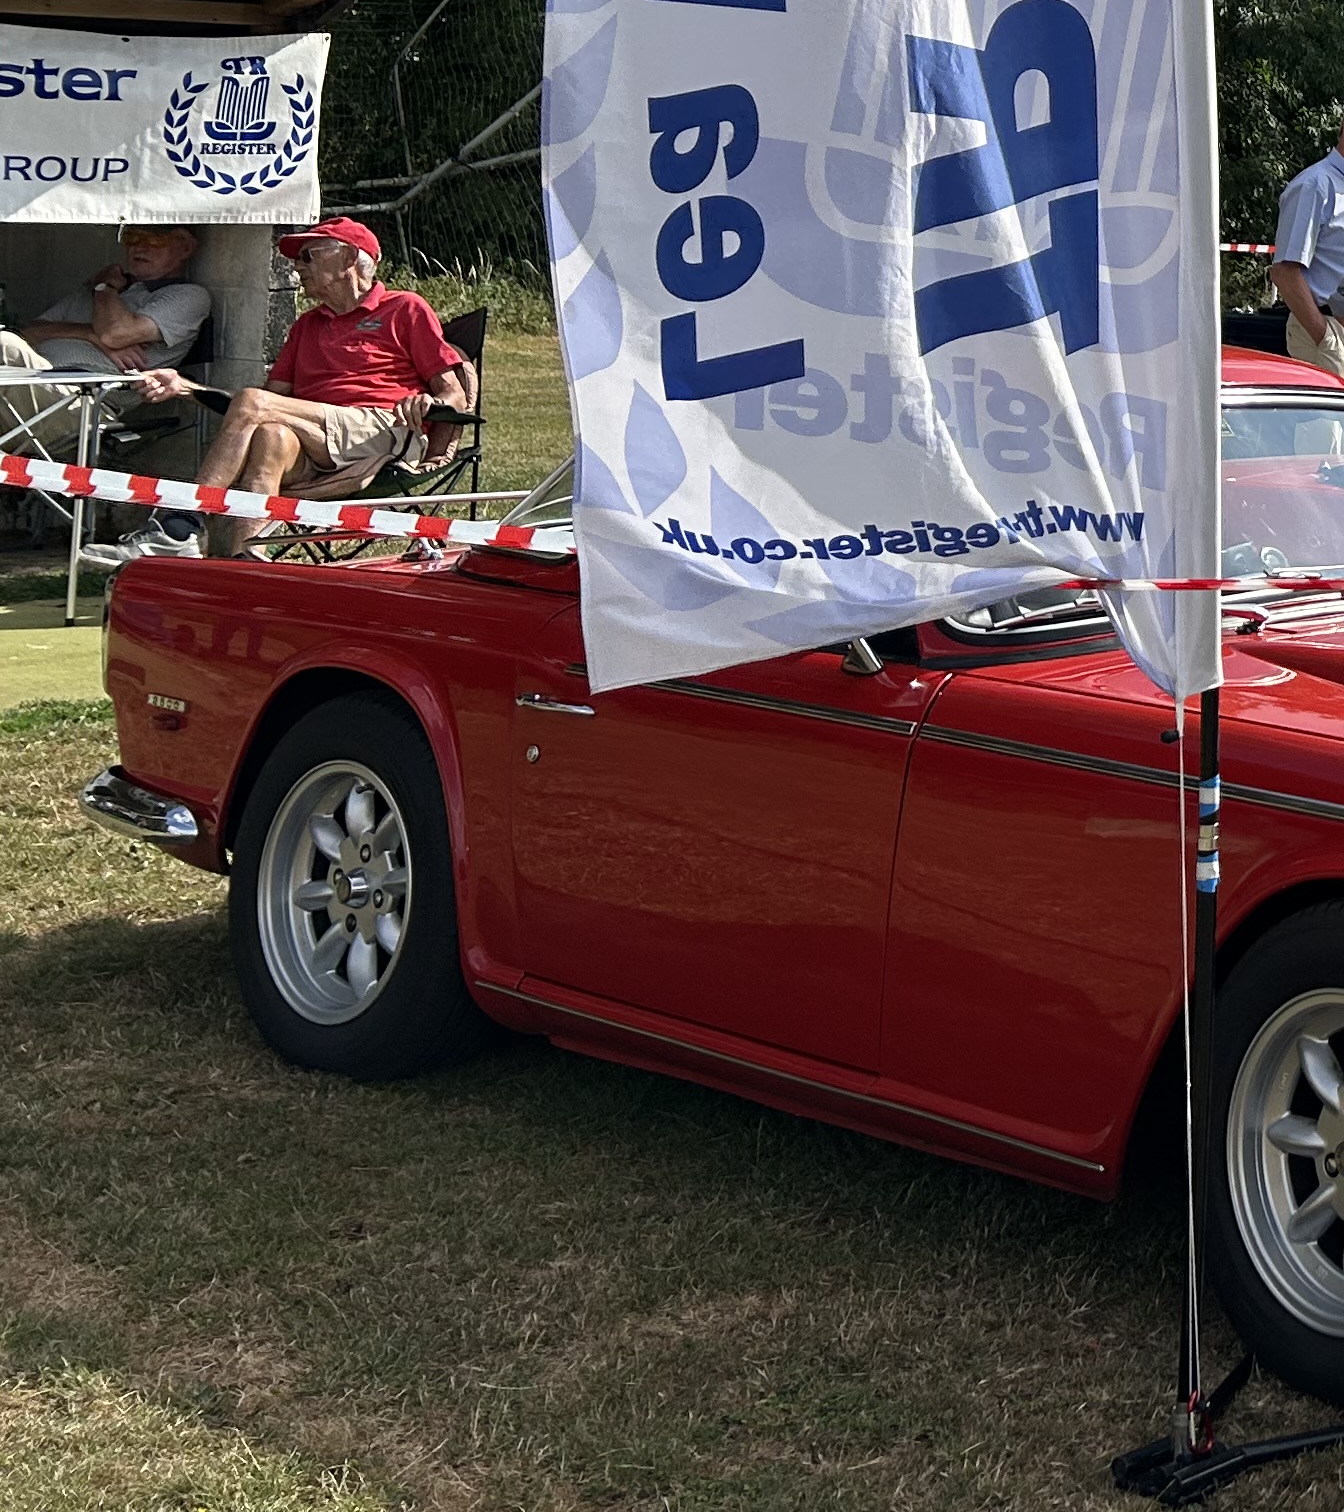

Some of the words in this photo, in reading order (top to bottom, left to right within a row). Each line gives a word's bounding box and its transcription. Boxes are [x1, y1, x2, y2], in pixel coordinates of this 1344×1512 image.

[221, 55, 268, 76] TR
[0, 58, 138, 101] ster
[199, 142, 278, 155] REGISTER
[3, 155, 130, 182] ROUP
